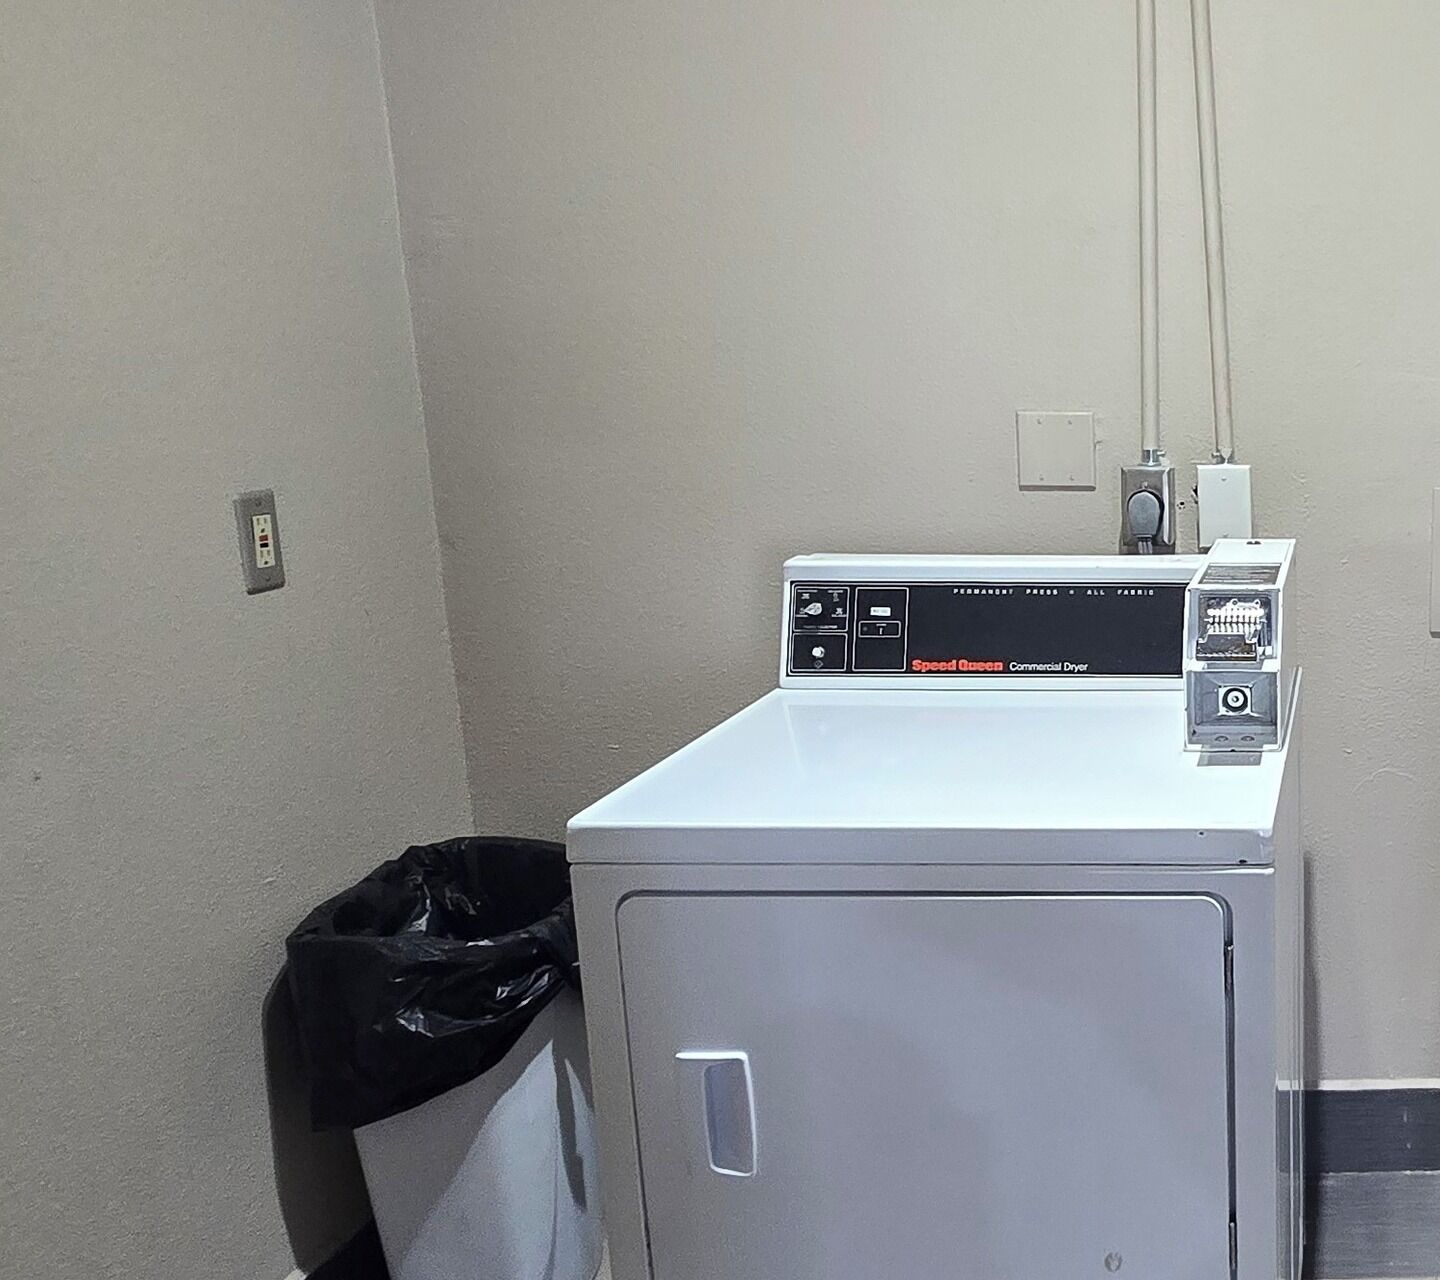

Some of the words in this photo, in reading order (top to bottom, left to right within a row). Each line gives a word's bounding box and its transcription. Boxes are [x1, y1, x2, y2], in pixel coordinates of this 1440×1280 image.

[911, 659, 957, 672] Speed
[958, 659, 1004, 671] Queen
[1009, 662, 1062, 671] Commercial
[1063, 662, 1088, 672] Dryer
